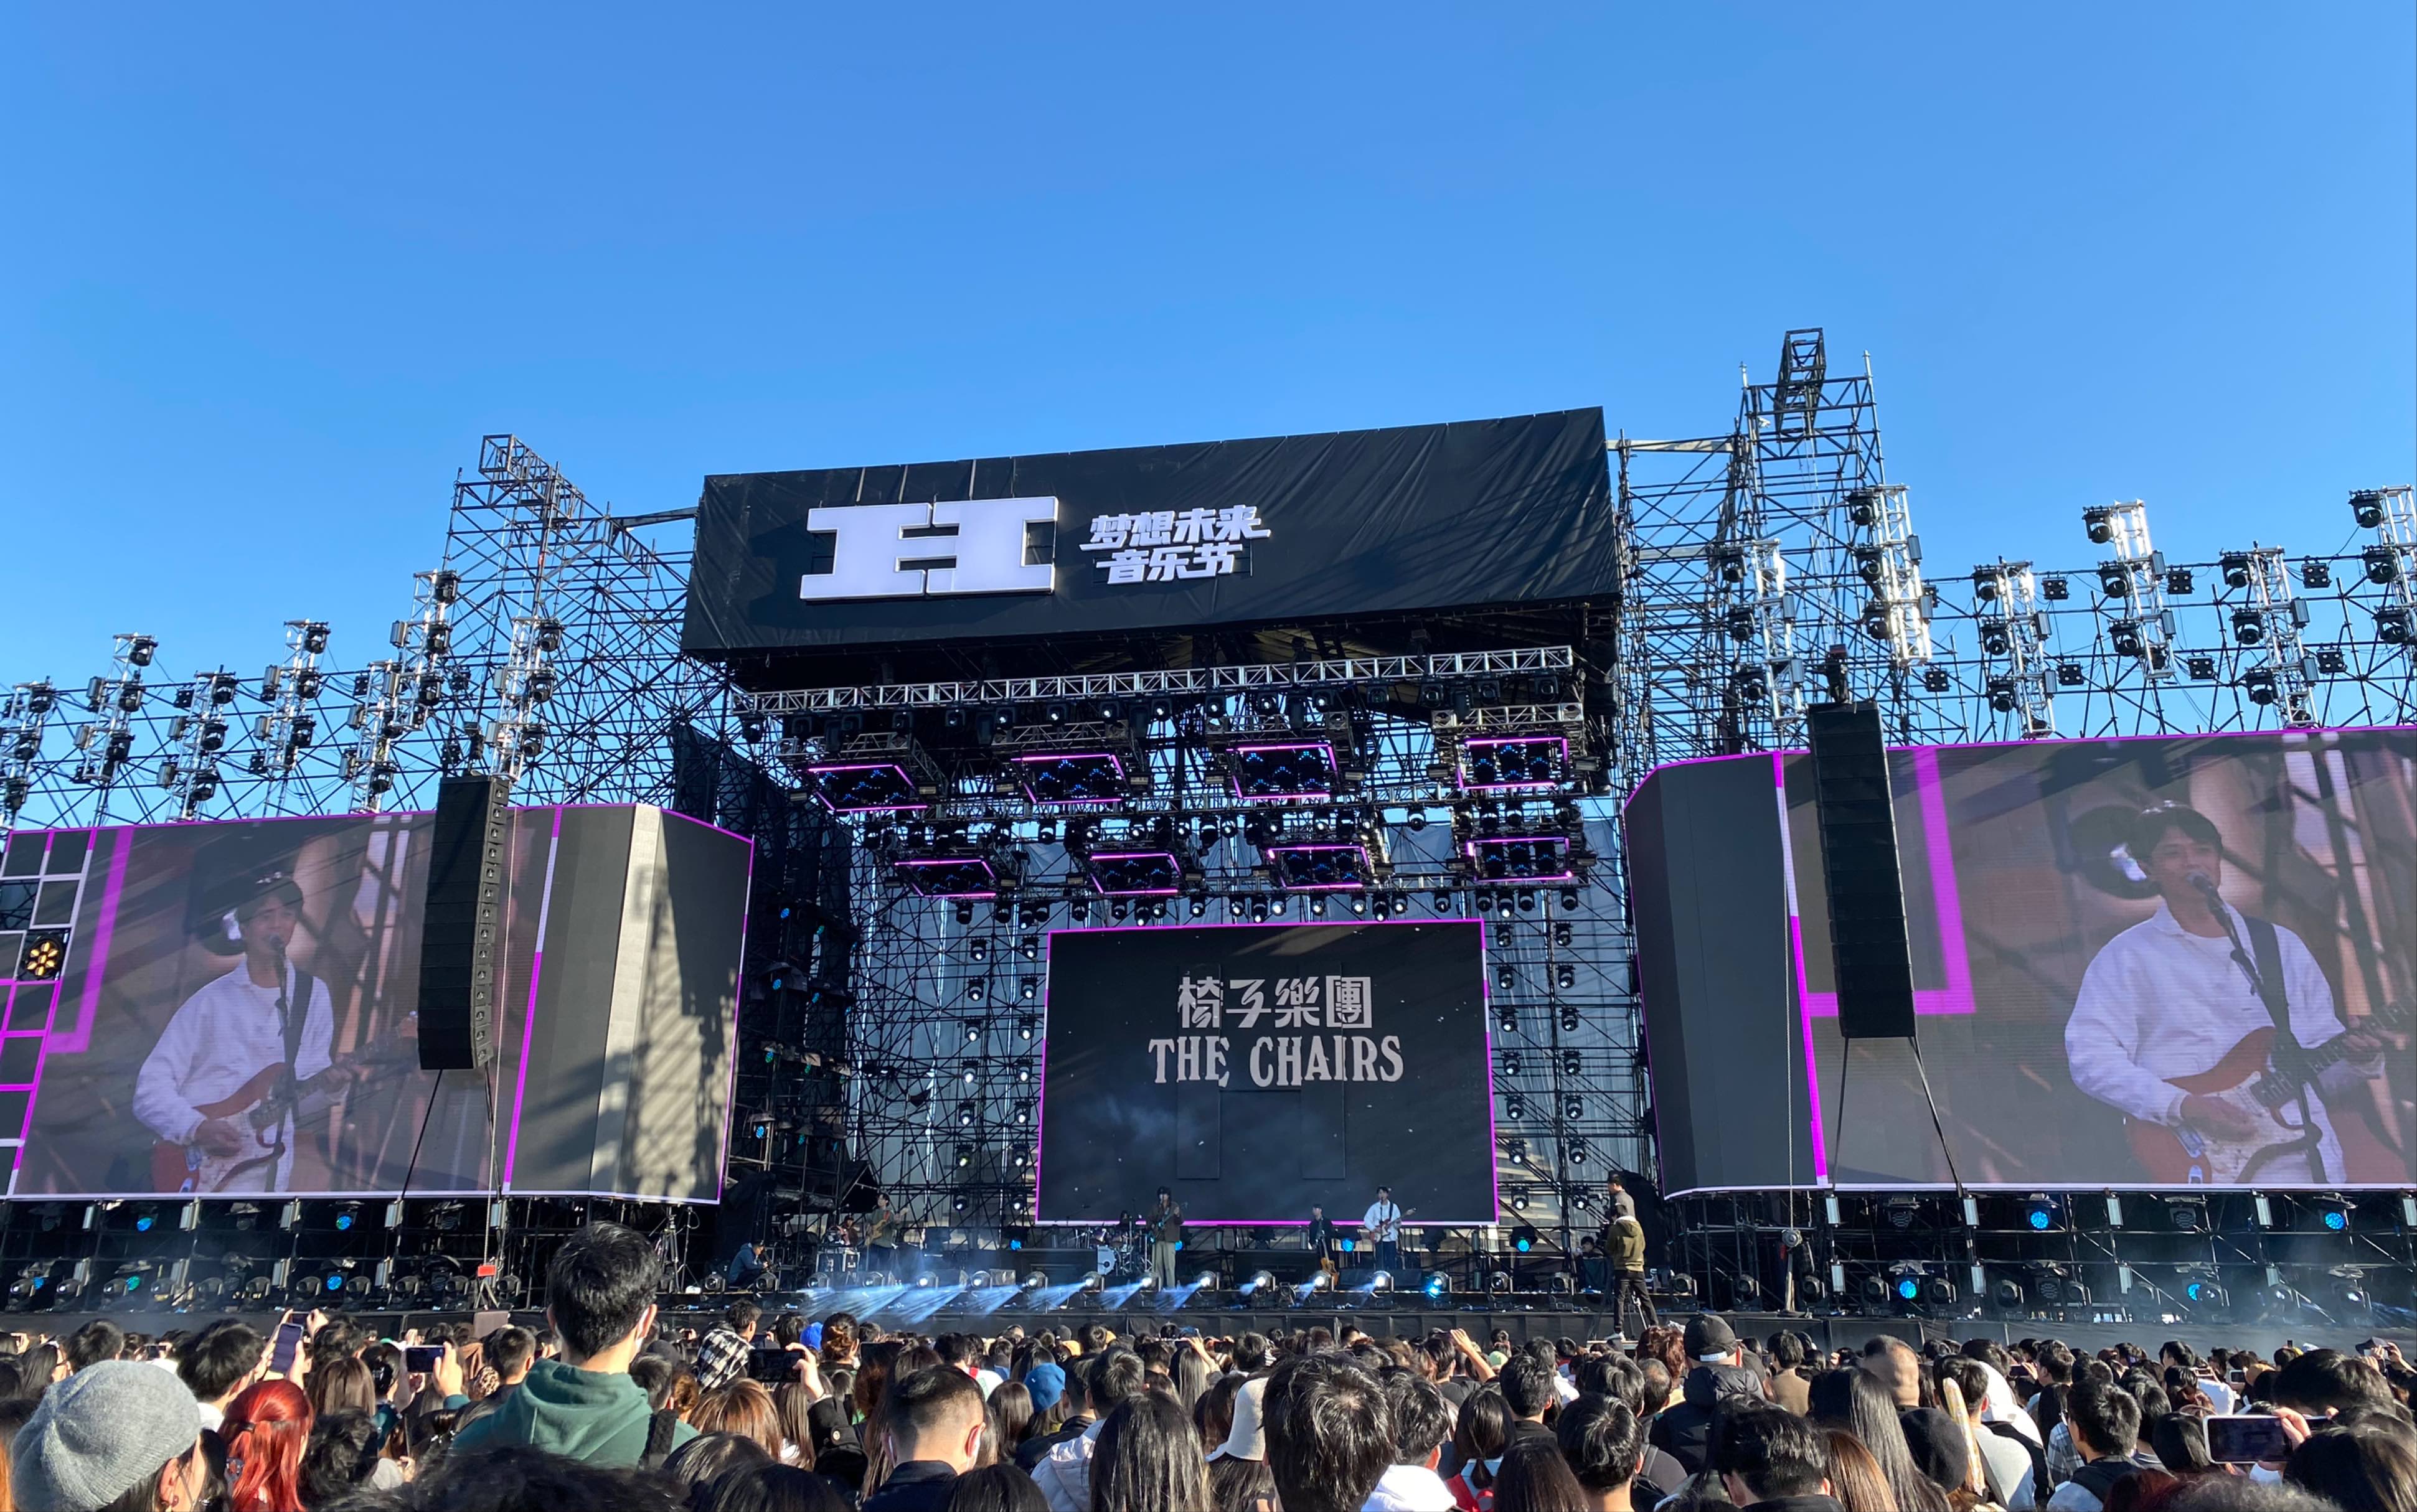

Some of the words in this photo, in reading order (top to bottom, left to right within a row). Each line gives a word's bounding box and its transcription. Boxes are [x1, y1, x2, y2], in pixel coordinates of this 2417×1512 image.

[1078, 504, 1272, 551] 梦想未来
[1095, 542, 1243, 585] 音乐节
[1177, 975, 1373, 1028] 椅子樂團
[1147, 1036, 1230, 1088] THE
[1249, 1035, 1404, 1087] CHAIRS
